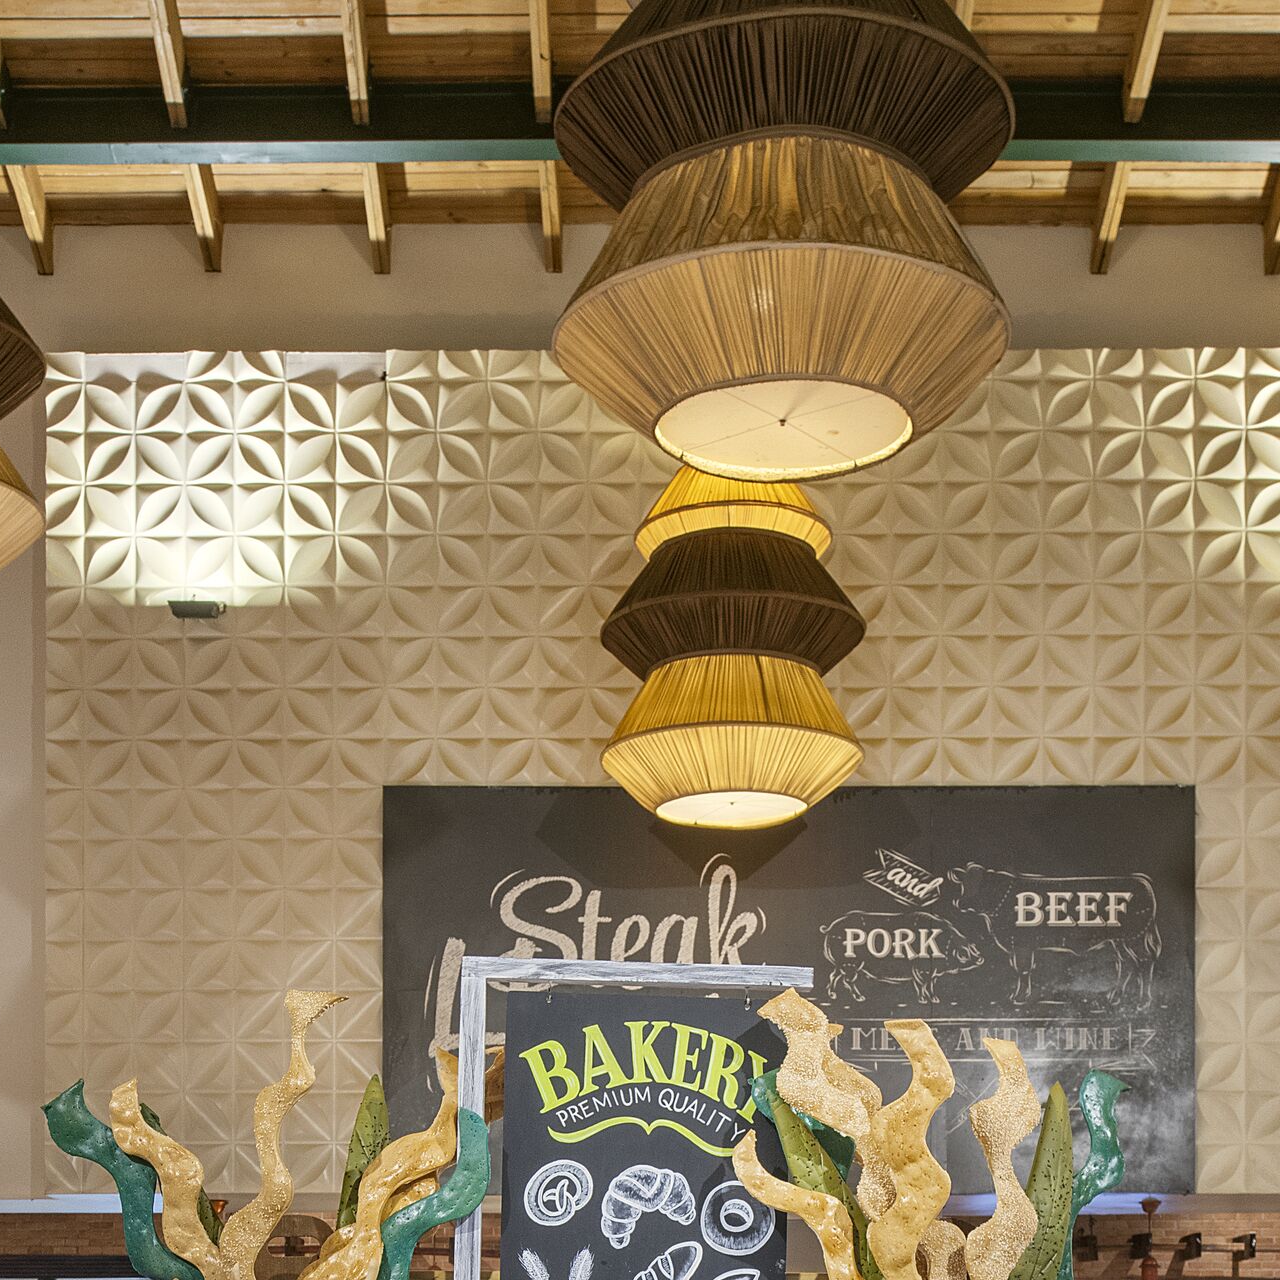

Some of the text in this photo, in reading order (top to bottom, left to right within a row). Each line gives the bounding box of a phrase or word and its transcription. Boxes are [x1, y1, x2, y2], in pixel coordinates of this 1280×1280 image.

[886, 867, 944, 898] and
[499, 863, 766, 965] Steak
[1014, 891, 1133, 928] BEEF
[842, 927, 947, 960] PORK
[1035, 1027, 1120, 1051] WINE
[556, 1085, 746, 1142] PREMIUM QUALITY
